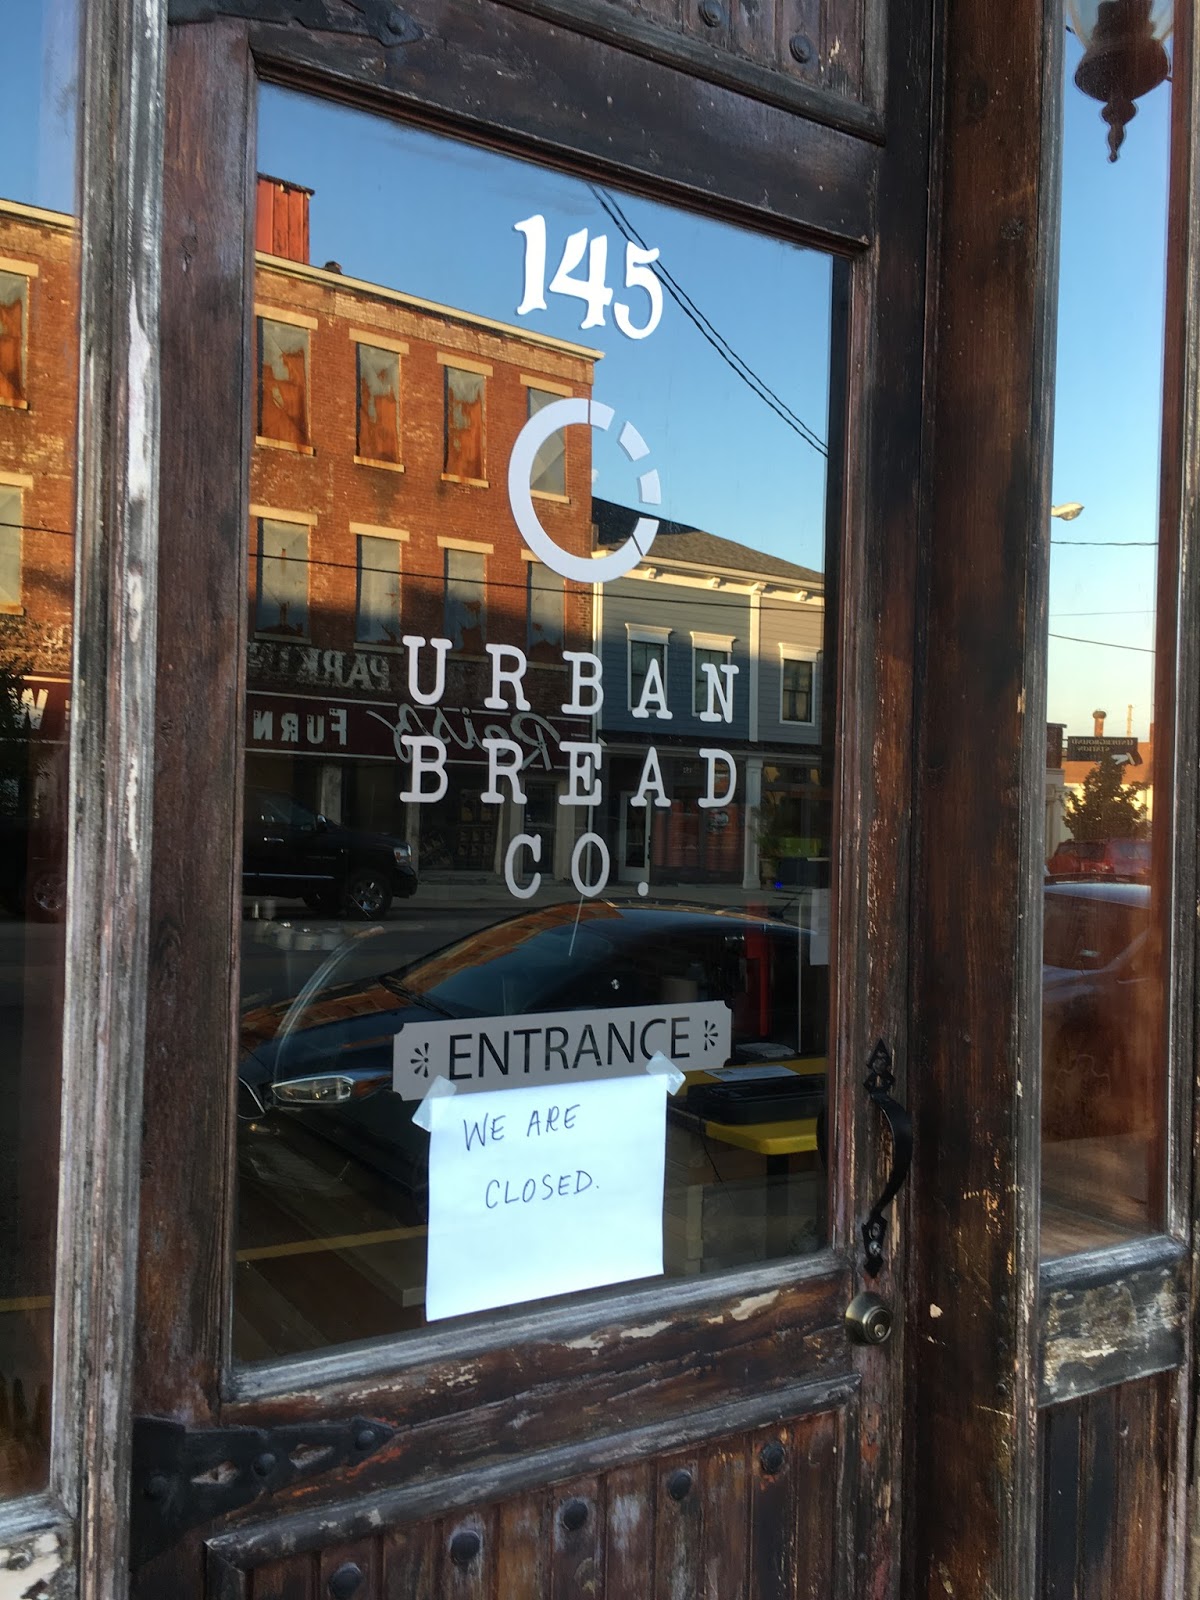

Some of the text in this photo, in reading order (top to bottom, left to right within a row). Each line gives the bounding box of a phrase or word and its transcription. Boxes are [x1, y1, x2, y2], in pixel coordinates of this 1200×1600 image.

[513, 214, 663, 340] 145
[402, 635, 740, 724] URBAN
[399, 735, 737, 808] BREAD
[505, 832, 648, 899] CO.
[449, 1016, 691, 1081] ENTRANCE
[463, 1103, 581, 1152] WE ARE
[485, 1169, 600, 1209] CLOSED.
